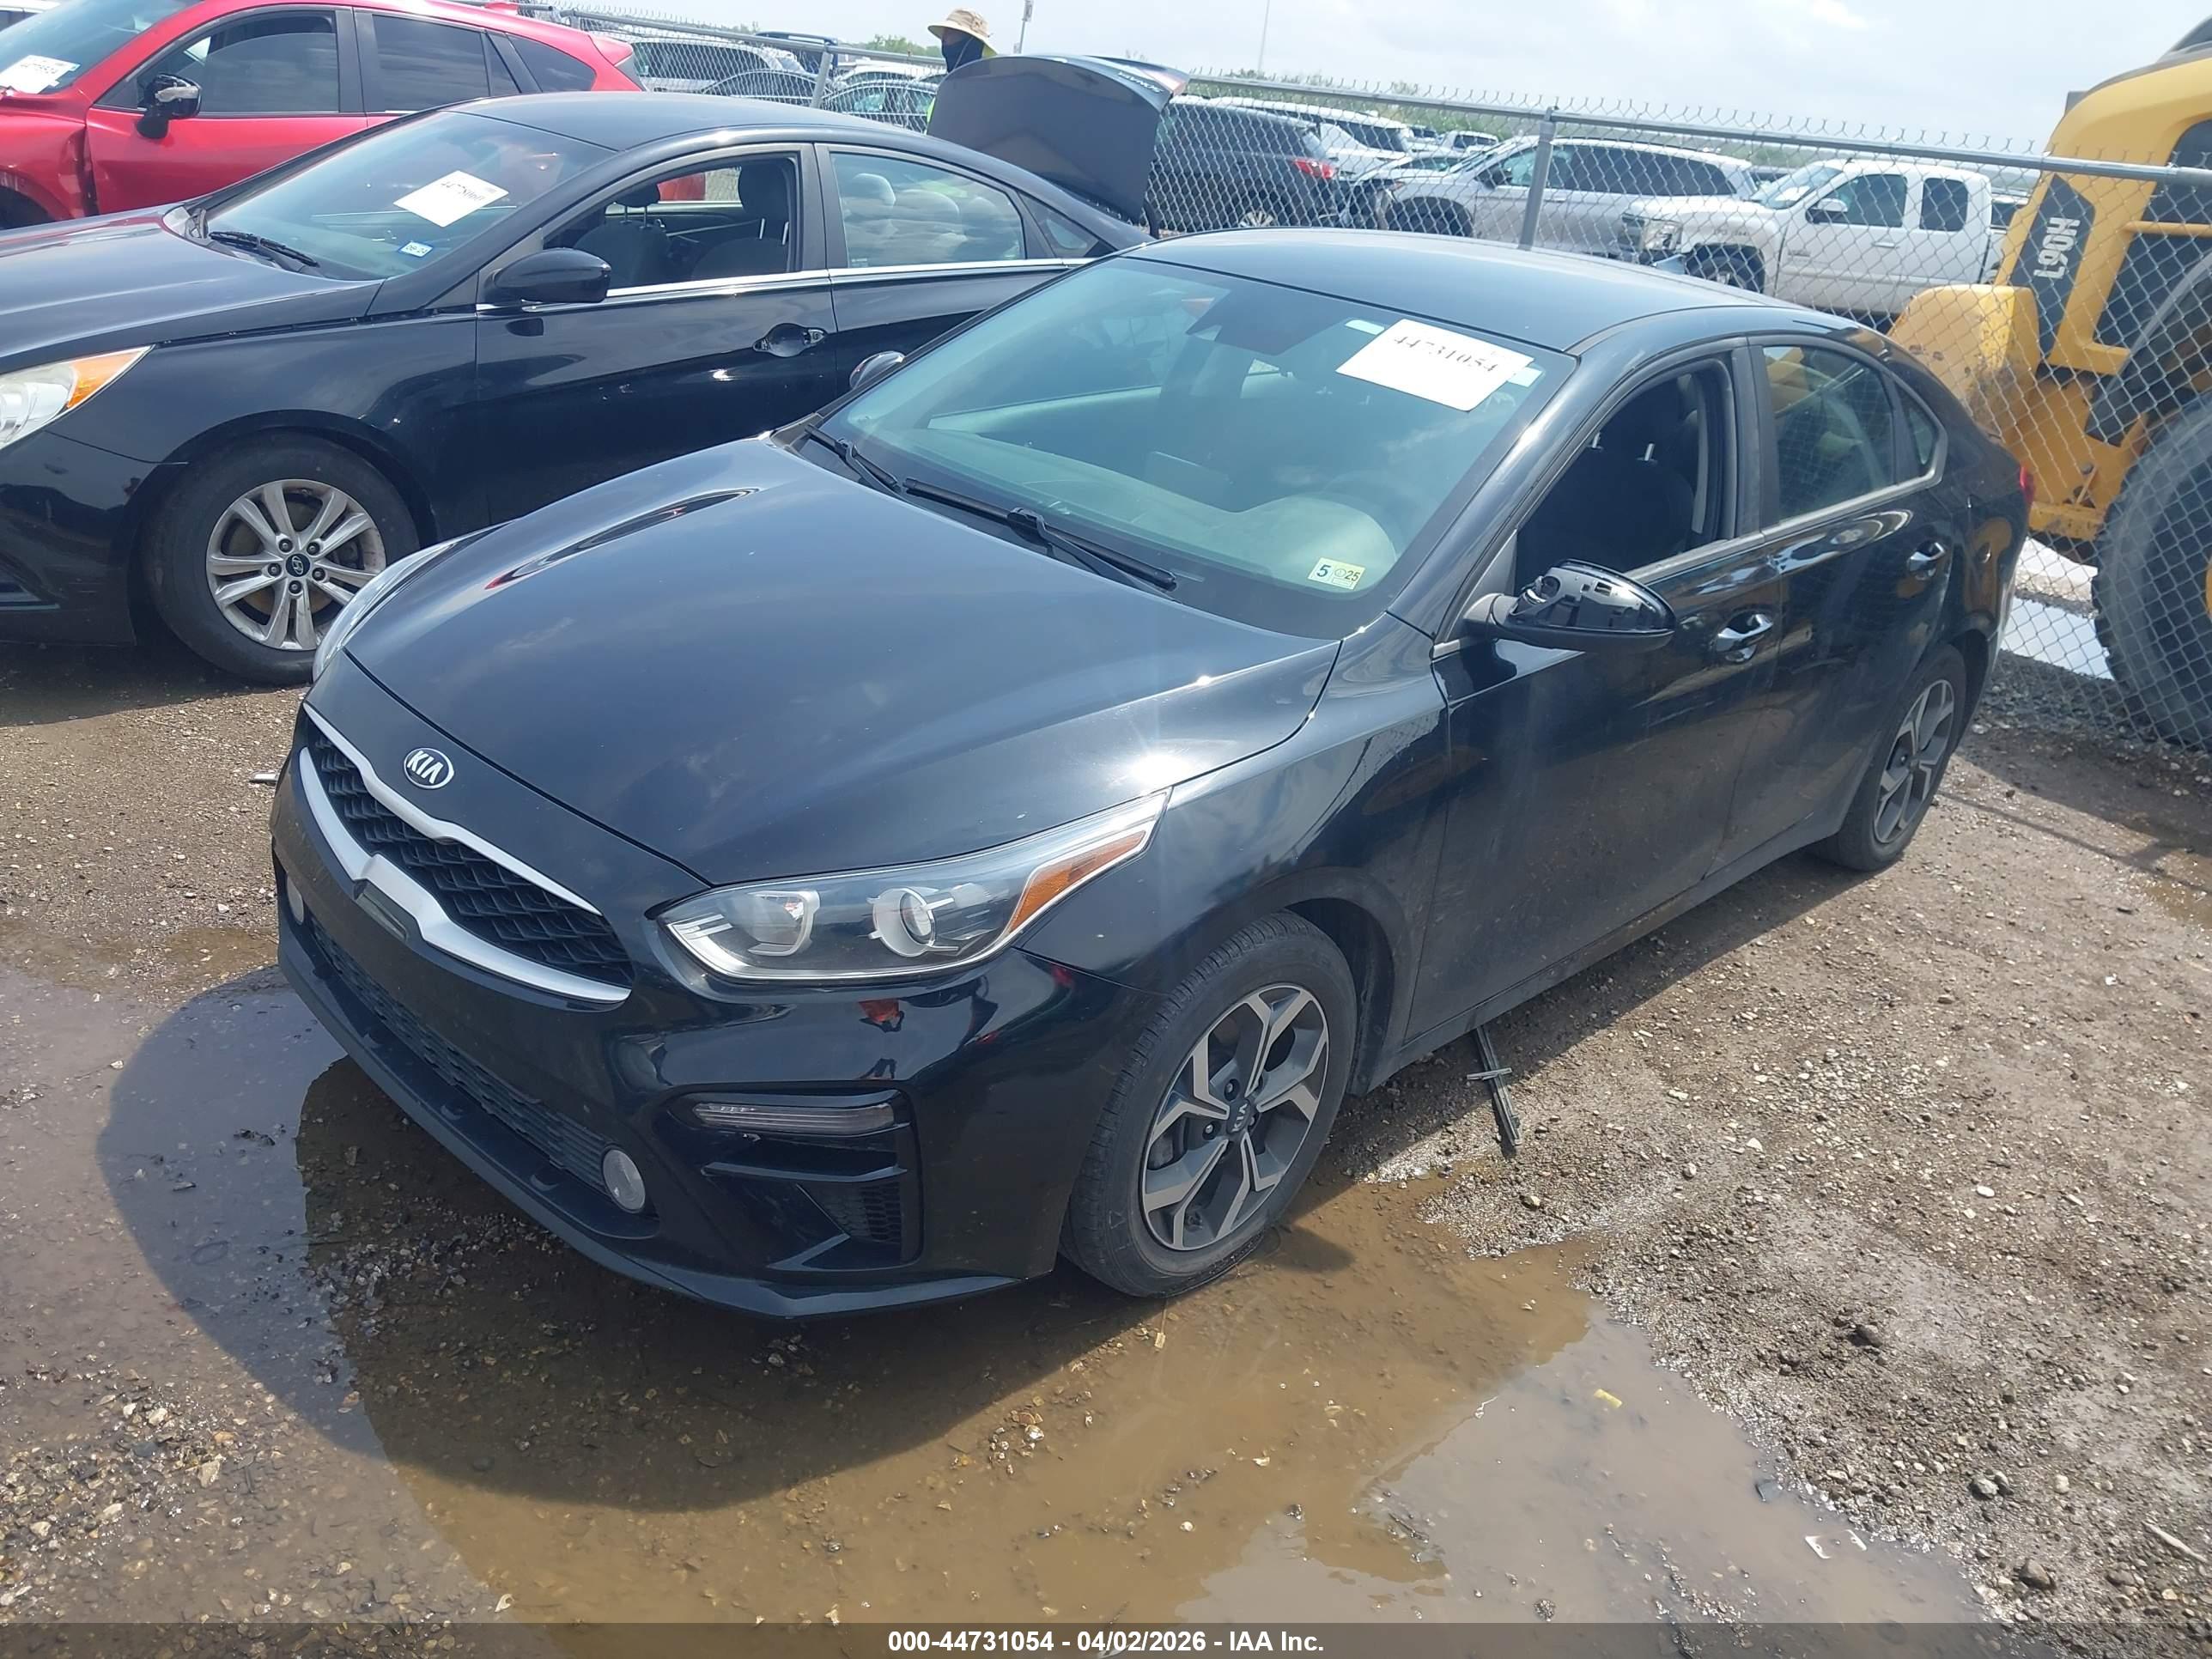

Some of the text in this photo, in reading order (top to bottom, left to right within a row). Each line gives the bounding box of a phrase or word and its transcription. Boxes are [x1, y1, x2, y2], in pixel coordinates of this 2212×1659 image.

[2033, 216, 2081, 279] L90H
[1394, 336, 1498, 373] 44731054
[1316, 563, 1360, 582] 5 25
[406, 750, 444, 784] KIA
[1231, 1103, 1248, 1132] KIA
